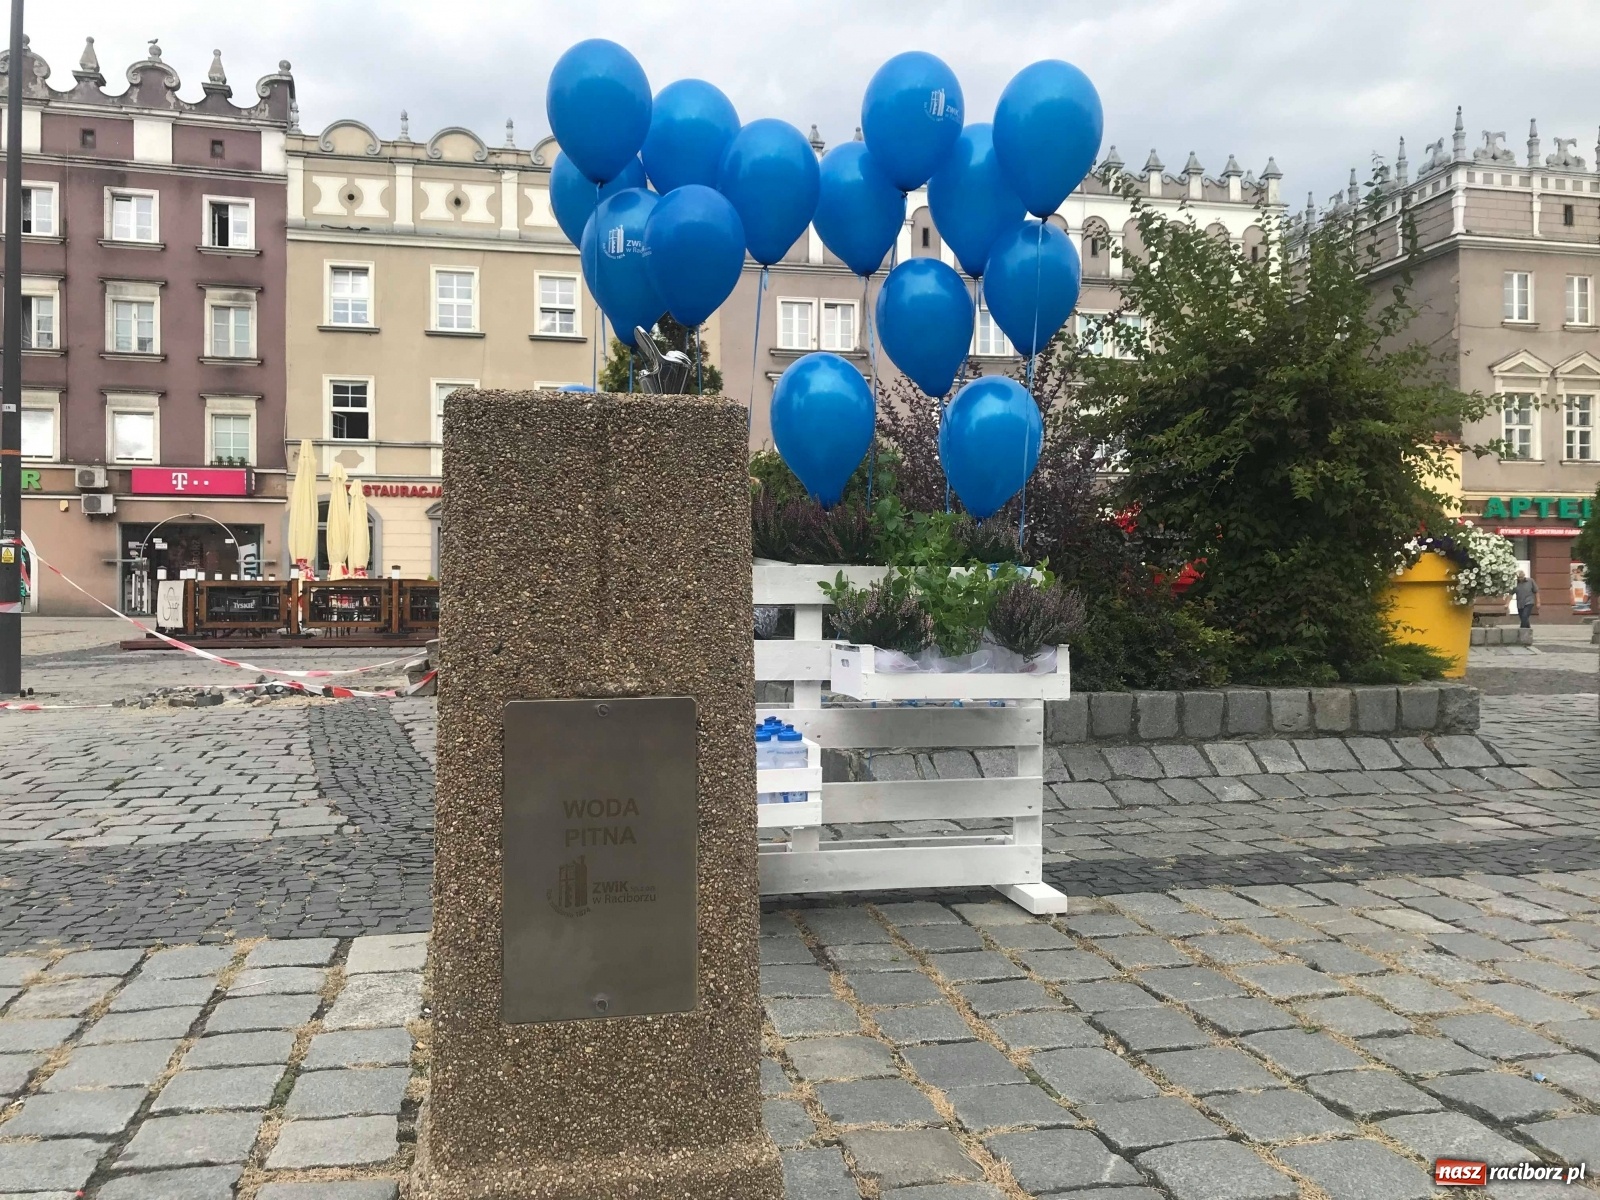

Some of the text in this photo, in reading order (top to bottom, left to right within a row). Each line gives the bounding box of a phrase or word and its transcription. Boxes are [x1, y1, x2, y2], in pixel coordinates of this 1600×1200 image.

[626, 239, 642, 247] ZWi
[345, 484, 442, 498] STAURACJA
[563, 798, 640, 819] WODA
[565, 826, 637, 847] PITNA
[592, 893, 656, 904] w Raciborzu
